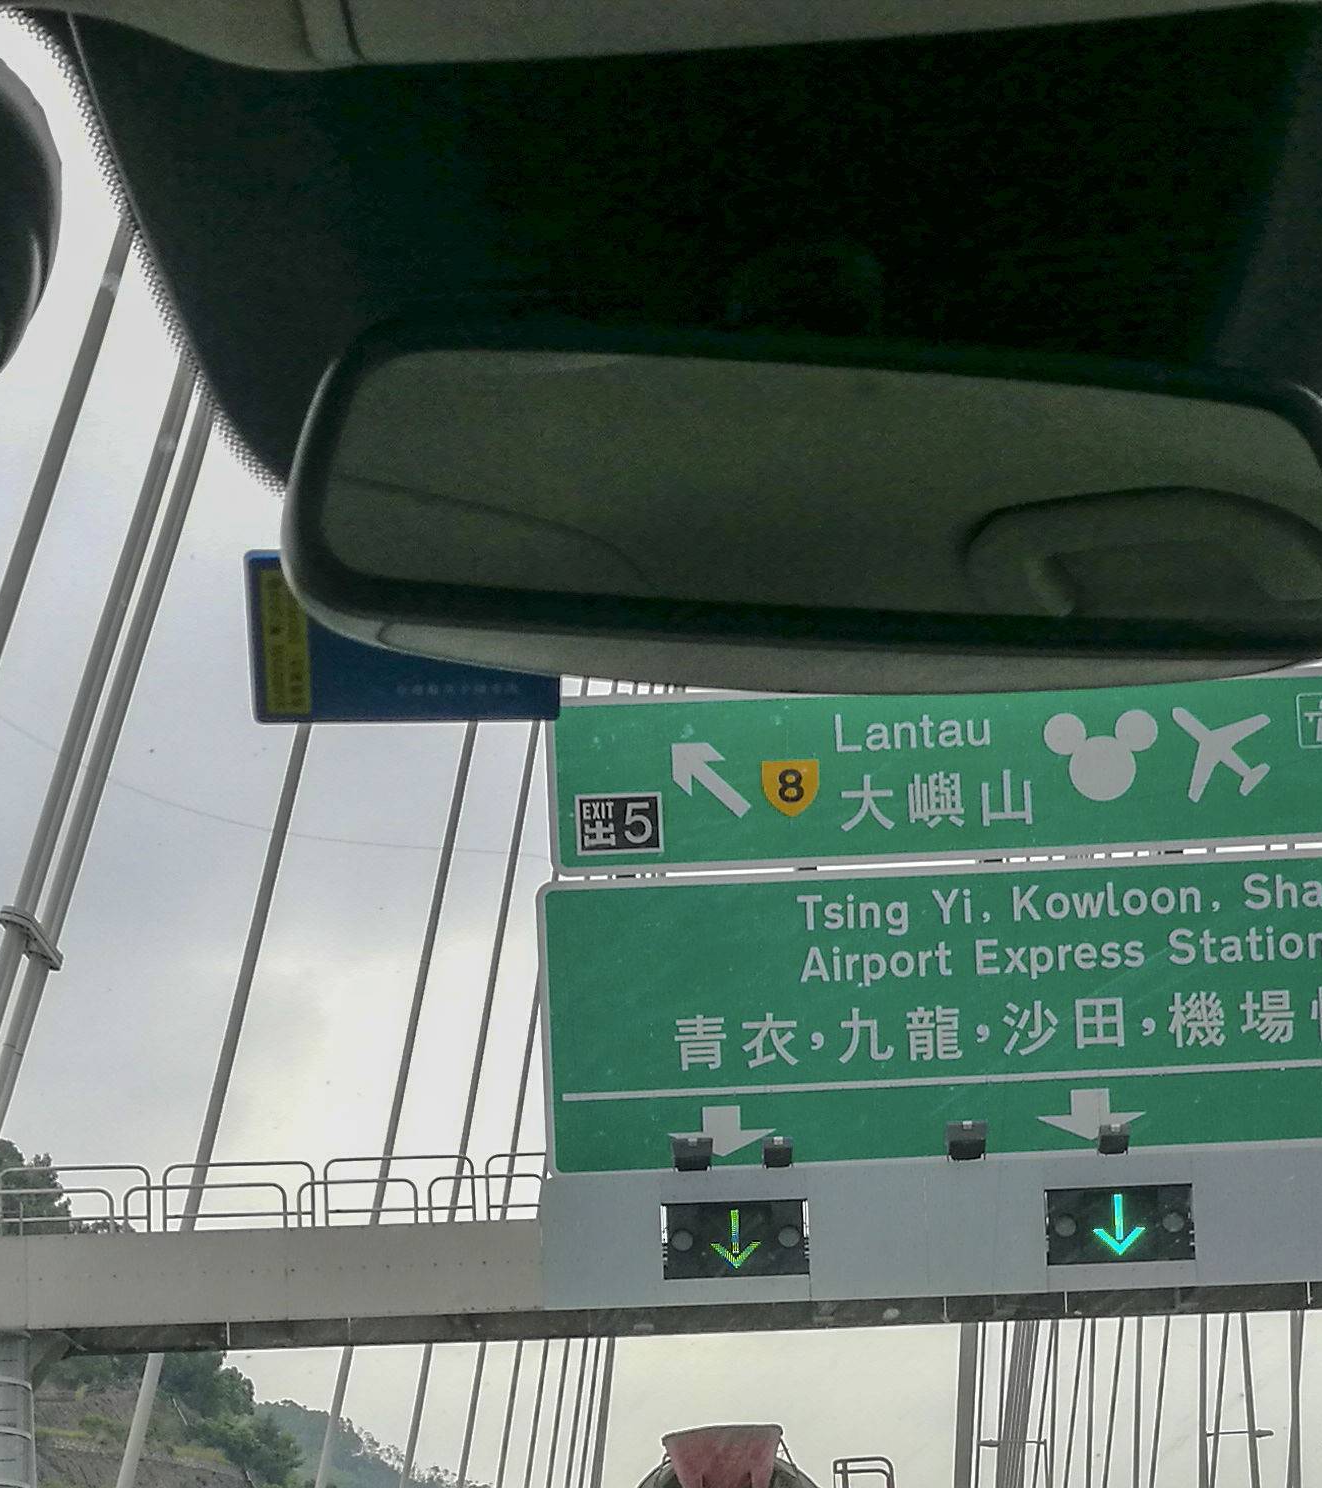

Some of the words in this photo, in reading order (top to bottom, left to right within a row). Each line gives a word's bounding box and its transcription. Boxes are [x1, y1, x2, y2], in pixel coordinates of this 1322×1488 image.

[834, 713, 992, 753] Lantau
[777, 768, 805, 804] 8
[840, 768, 1033, 832] 大嶼山
[582, 800, 615, 821] EXIT
[624, 802, 654, 844] 5
[583, 820, 617, 848] 出
[796, 893, 909, 936] Tsing
[932, 887, 991, 925] Yi,
[1012, 880, 1221, 922] Kowloon,
[799, 940, 953, 987] Airport
[974, 935, 1146, 980] Express
